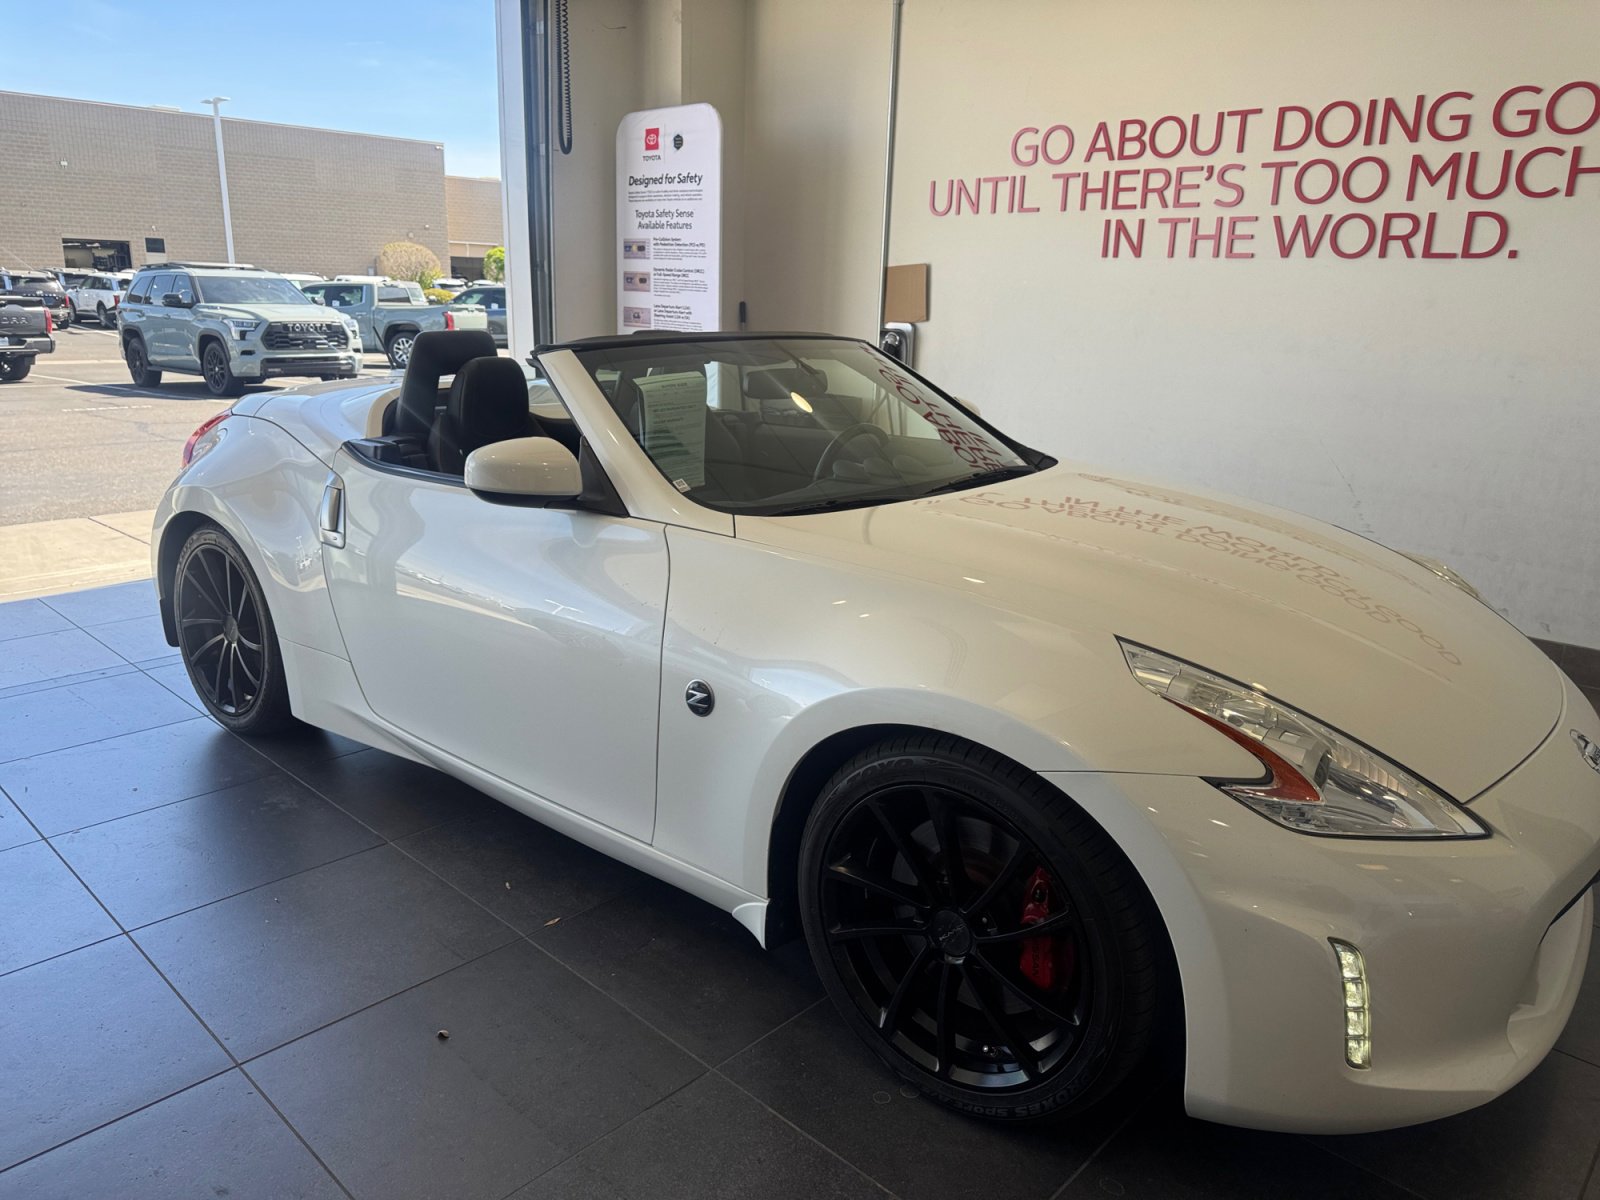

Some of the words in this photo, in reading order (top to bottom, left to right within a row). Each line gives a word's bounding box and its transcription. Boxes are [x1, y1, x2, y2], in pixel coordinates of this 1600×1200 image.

[1012, 126, 1073, 166] GO
[1085, 108, 1260, 162] ABOUT
[1274, 92, 1473, 152] DOING
[1492, 81, 1600, 138] GO
[628, 173, 664, 188] Designed
[664, 172, 676, 185] for
[677, 171, 703, 186] Safety
[929, 176, 1038, 217] UNTIL
[1053, 163, 1244, 210] THERE'S
[1261, 157, 1389, 204] TOO
[1407, 146, 1600, 200] MUCH
[635, 210, 655, 220] Toyota
[655, 209, 675, 219] Safety
[675, 209, 694, 218] Sense
[637, 220, 665, 230] Available
[666, 220, 693, 230] Features
[1101, 218, 1144, 258] IN
[1158, 215, 1255, 258] THE
[1274, 210, 1517, 260] WORLD.
[287, 323, 329, 332] TOYOTA
